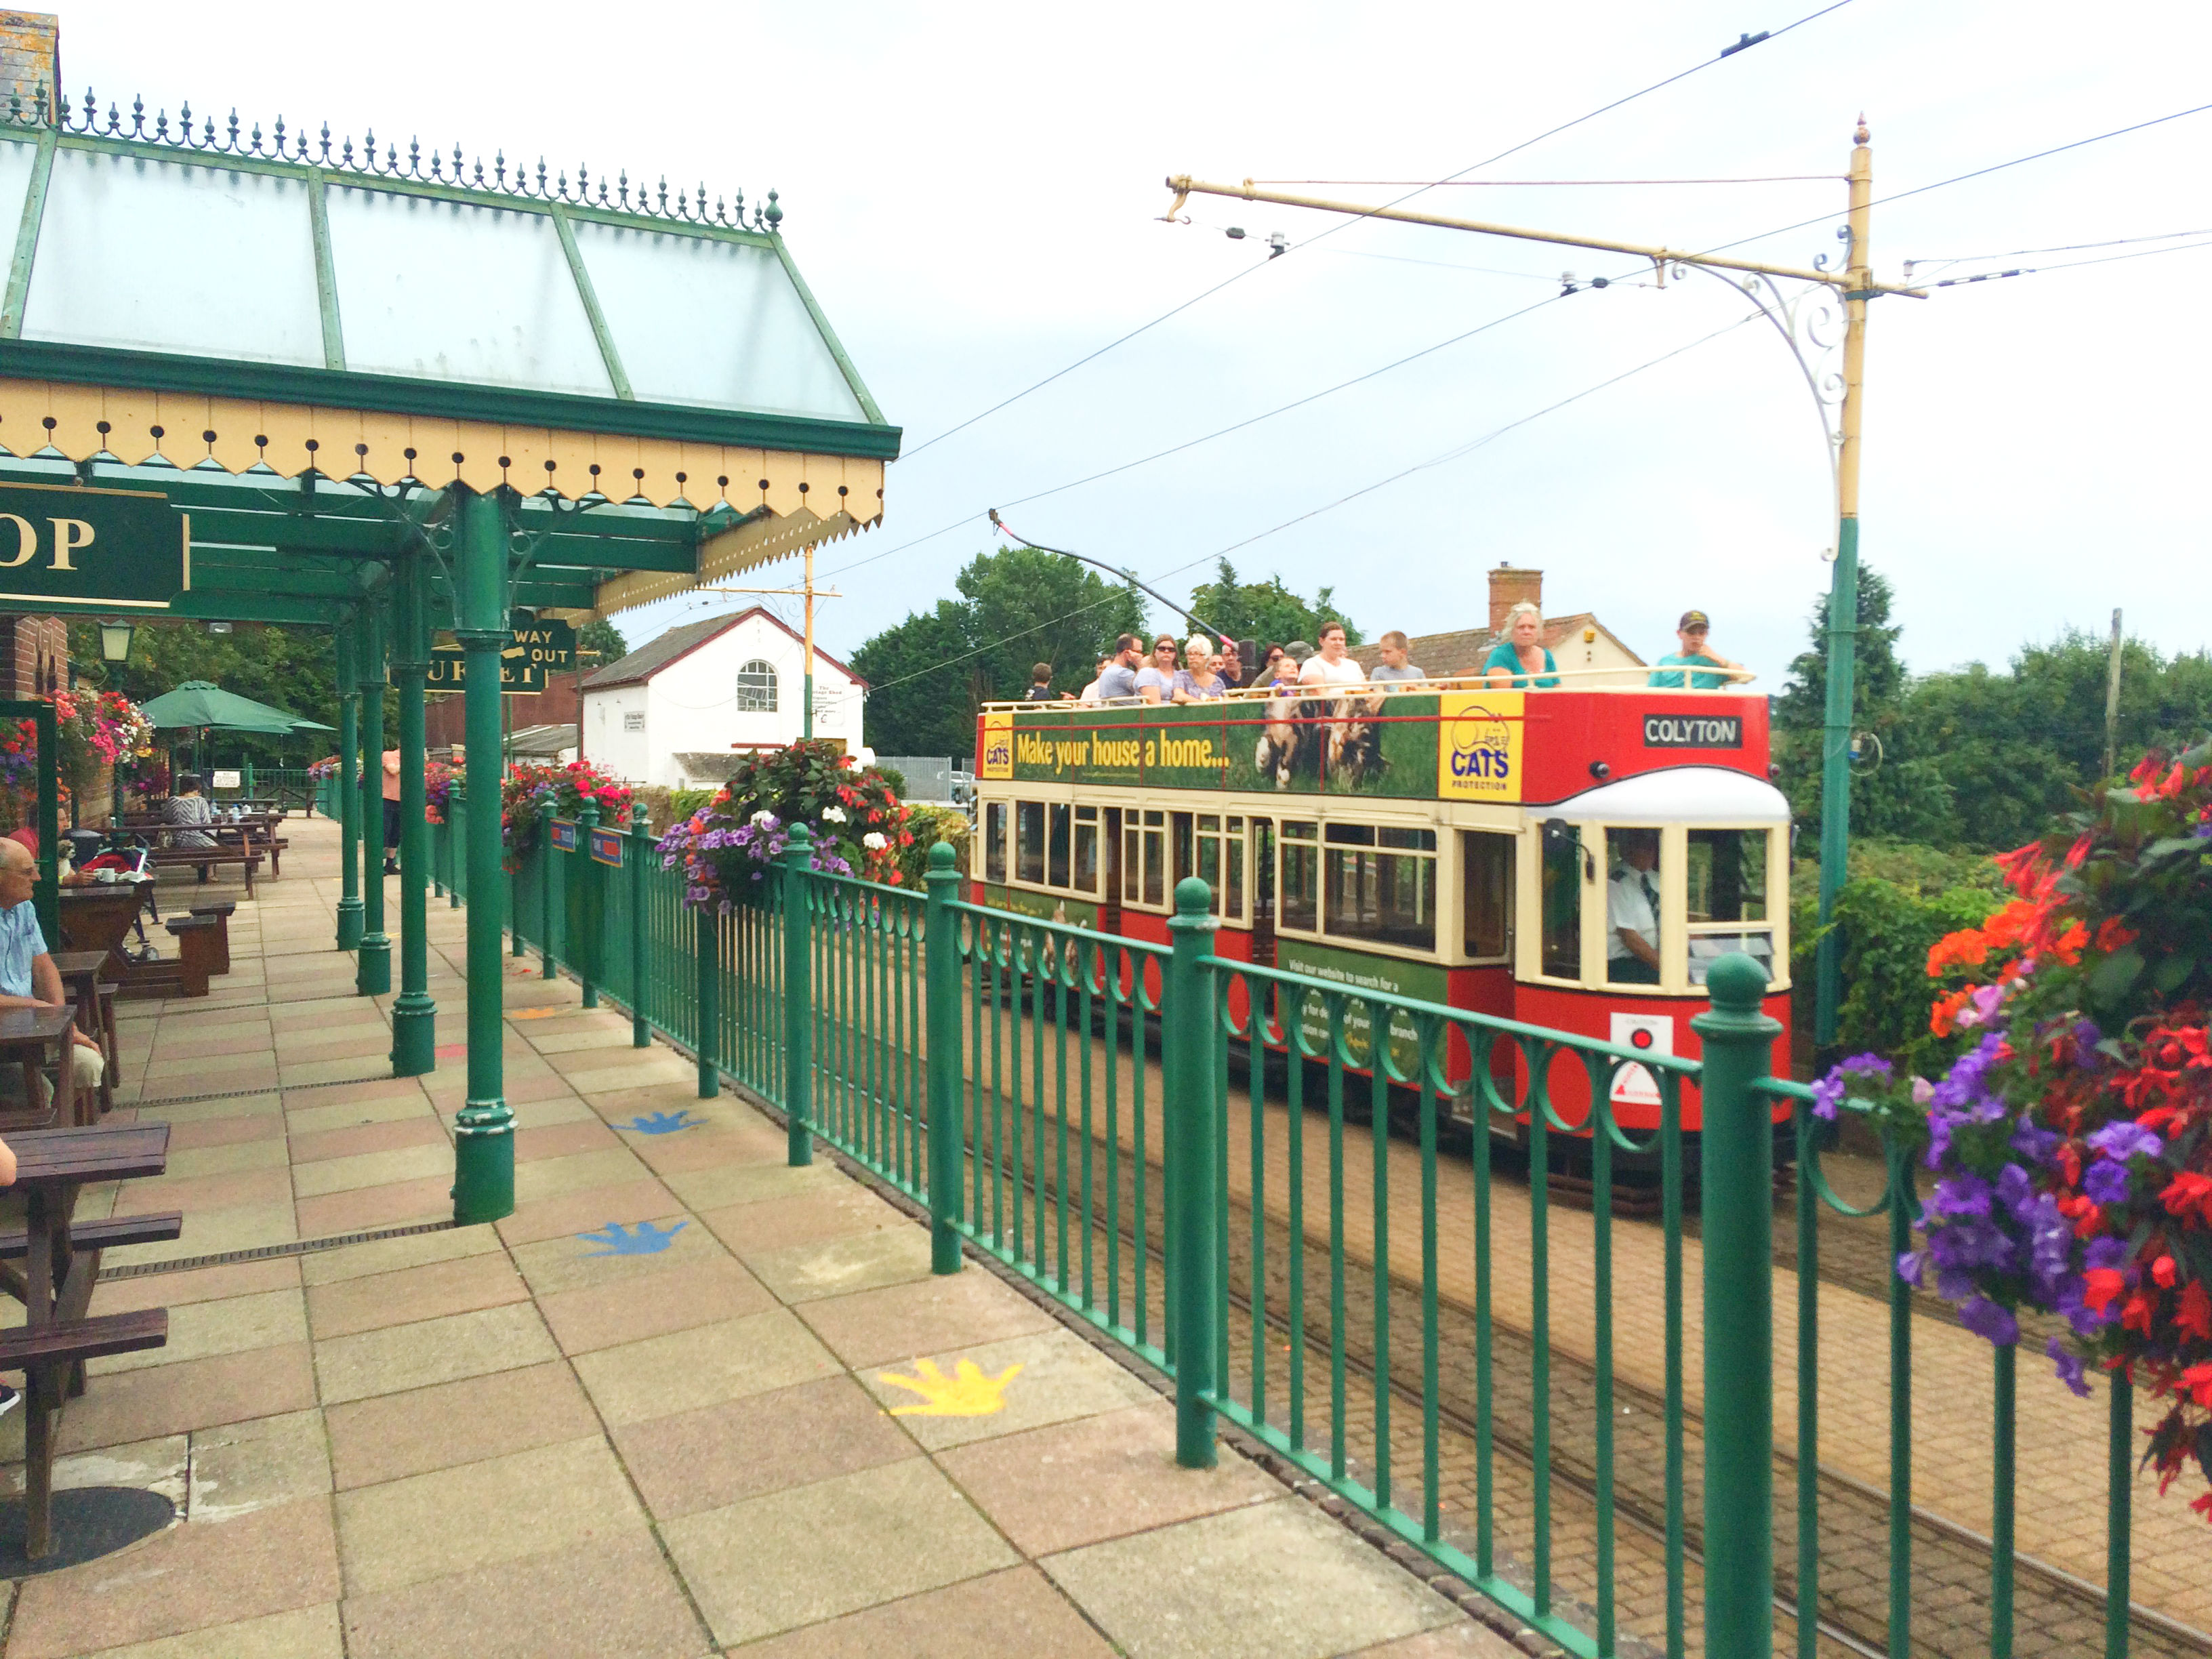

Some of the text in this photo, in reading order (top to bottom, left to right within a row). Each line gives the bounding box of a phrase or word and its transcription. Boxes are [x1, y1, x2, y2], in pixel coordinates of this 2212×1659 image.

[514, 630, 552, 643] WAY
[531, 649, 568, 663] OUT
[1645, 719, 1736, 743] COLYTON
[987, 747, 1009, 764] CATS
[1017, 729, 1230, 775] Make your house a home...
[1452, 747, 1509, 778] CATS
[1452, 780, 1507, 790] PROTECTION
[1289, 959, 1304, 973] Visit
[1317, 966, 1345, 981] website
[1345, 971, 1355, 983] to
[1355, 975, 1379, 988] search
